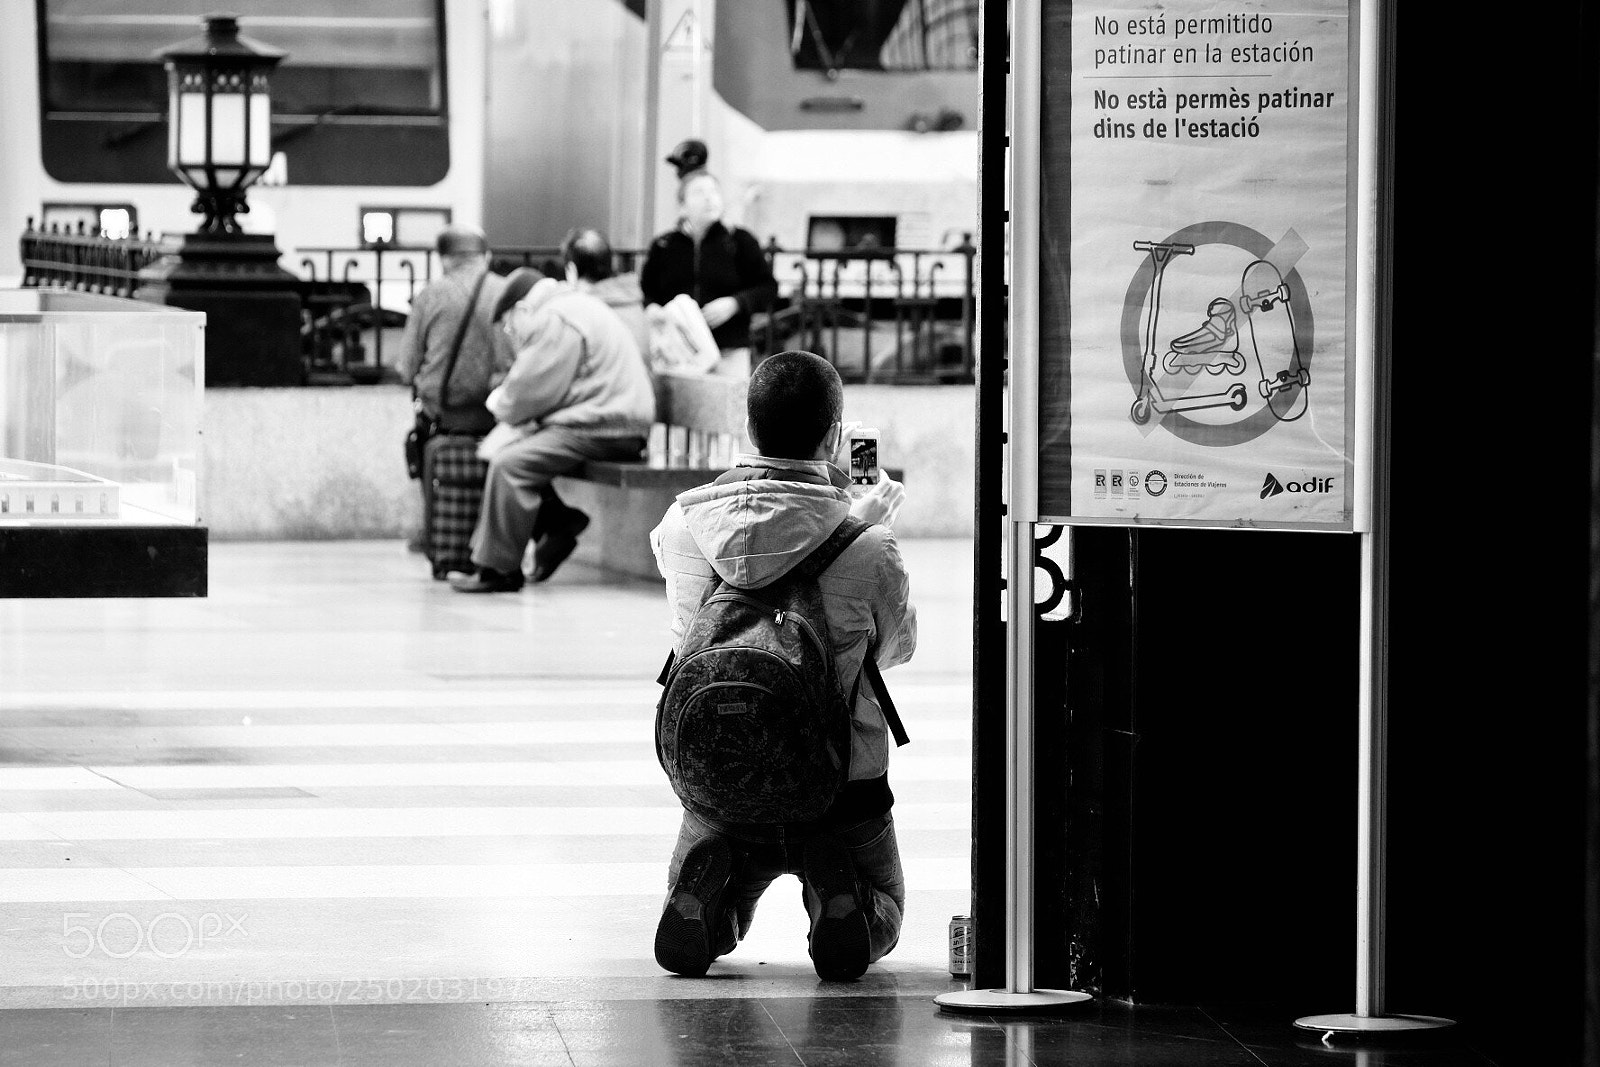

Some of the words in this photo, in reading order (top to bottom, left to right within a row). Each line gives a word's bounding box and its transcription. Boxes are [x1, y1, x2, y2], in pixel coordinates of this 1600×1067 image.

[1094, 15, 1119, 35] No
[1127, 13, 1165, 35] está
[1175, 14, 1272, 38] permitido
[1095, 44, 1166, 68] patinar
[1173, 47, 1196, 63] en
[1205, 43, 1222, 63] la
[1231, 41, 1314, 63] estación
[1094, 90, 1119, 109] No
[1127, 88, 1167, 109] està
[1176, 87, 1250, 113] permès
[1258, 87, 1334, 113] patinar
[1094, 117, 1135, 138] dins
[1143, 118, 1167, 138] de
[1175, 116, 1260, 138] l'estació
[1286, 477, 1335, 493] adif
